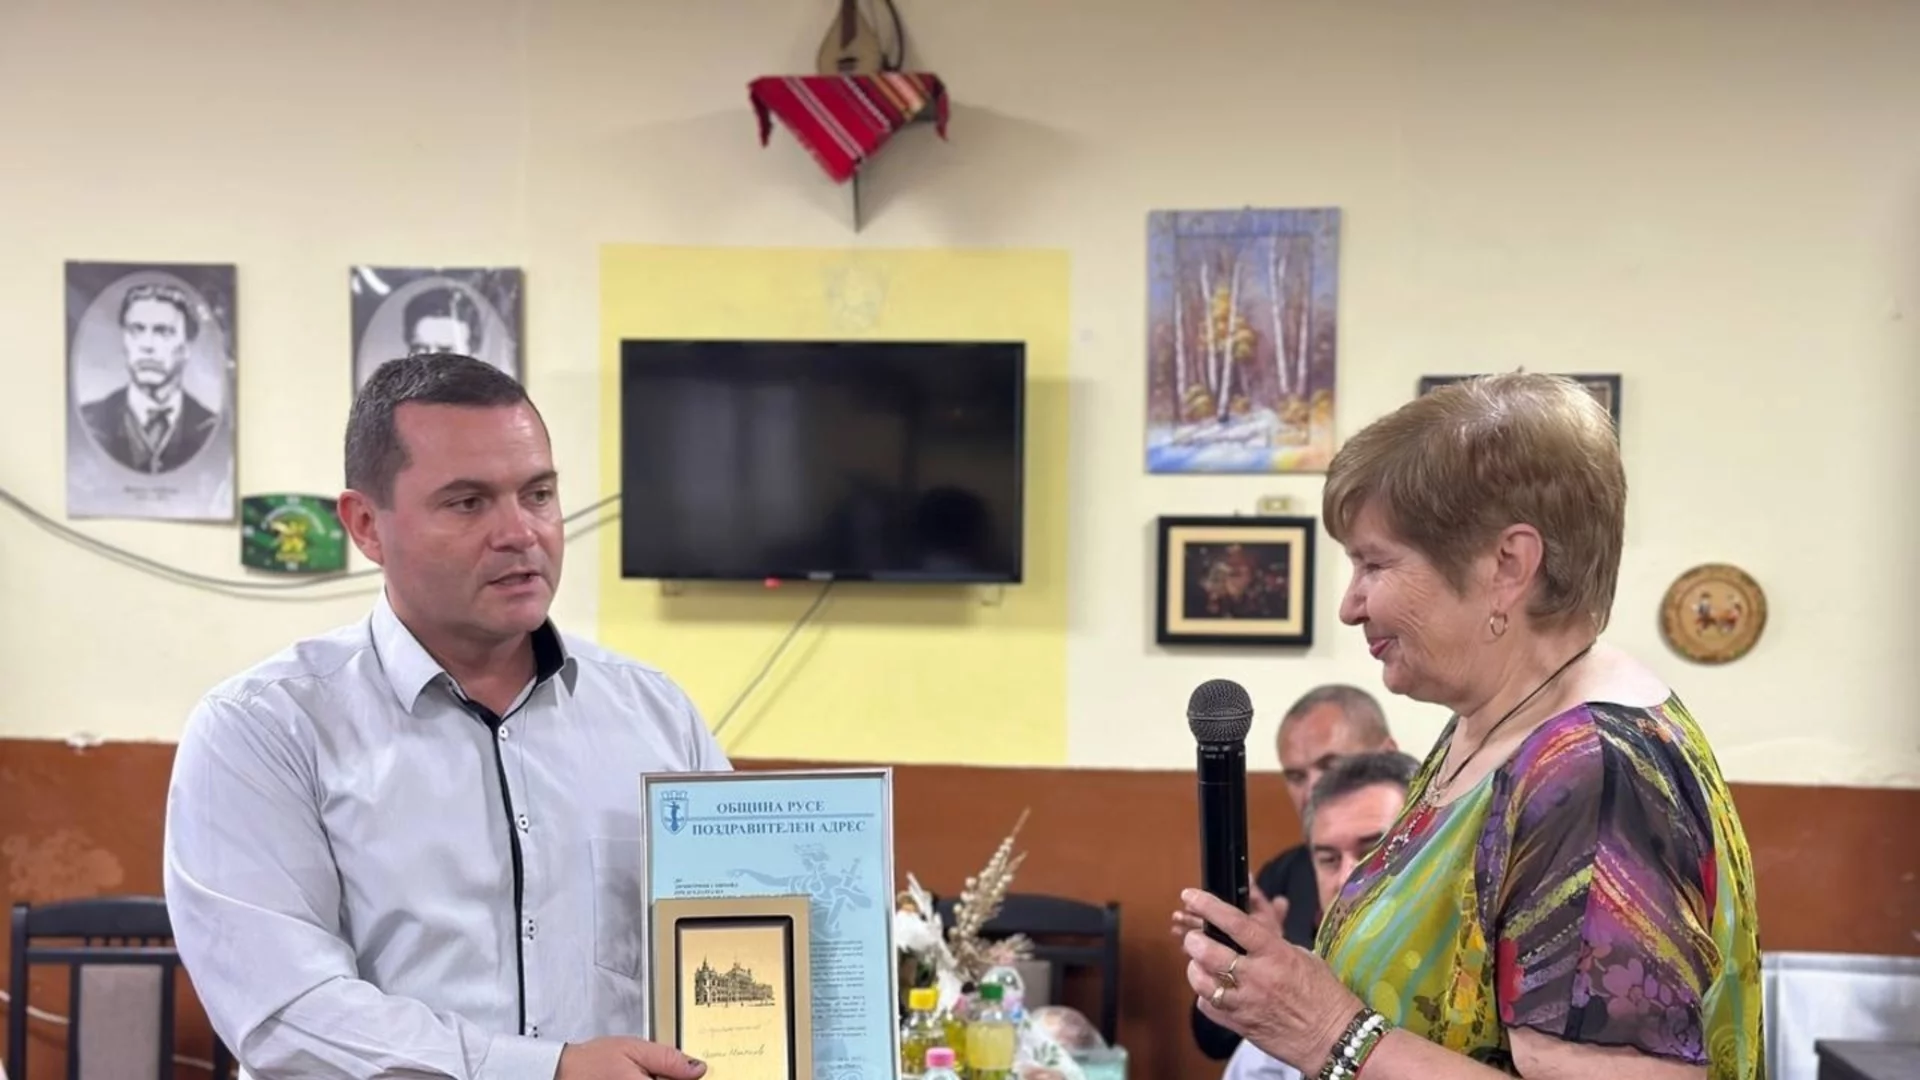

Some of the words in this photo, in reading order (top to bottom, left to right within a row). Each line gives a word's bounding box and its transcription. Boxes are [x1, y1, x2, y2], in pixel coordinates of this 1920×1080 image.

[717, 801, 783, 814] ОБЩИНА
[788, 800, 825, 812] РУСЕ
[692, 821, 815, 836] ПОЗДРАВИТЕЛЕН
[820, 820, 866, 834] АДРЕС
